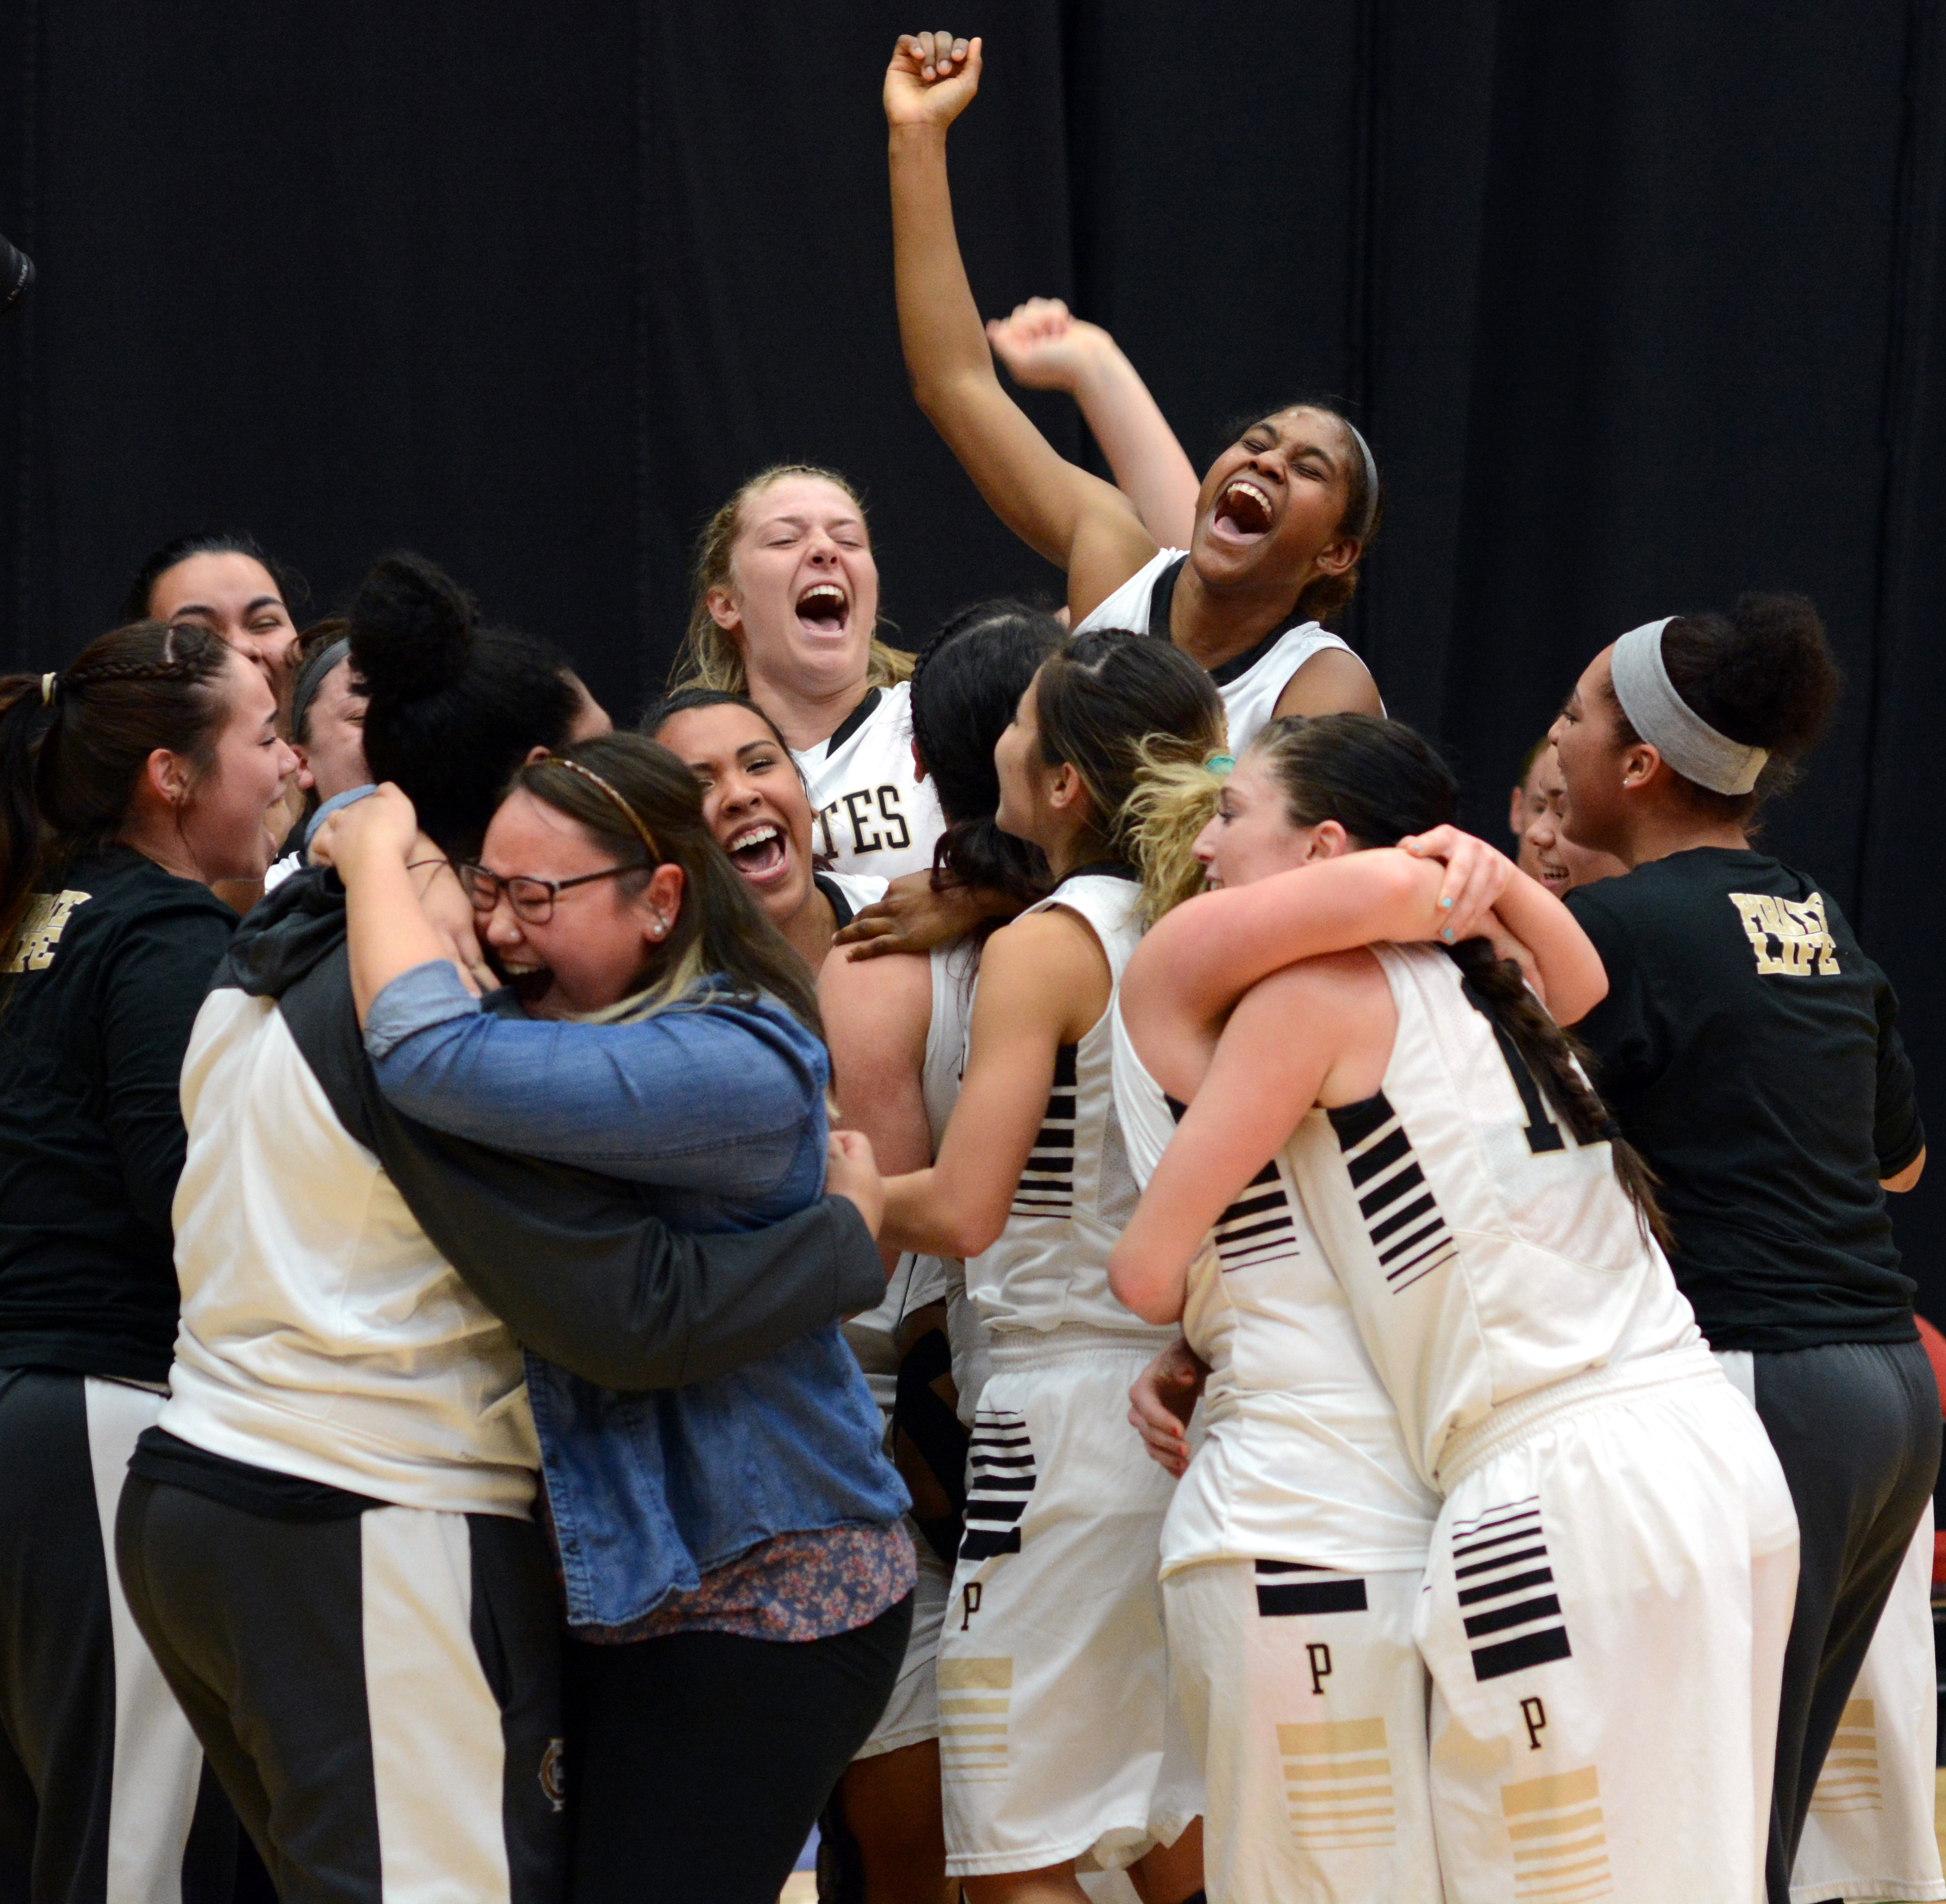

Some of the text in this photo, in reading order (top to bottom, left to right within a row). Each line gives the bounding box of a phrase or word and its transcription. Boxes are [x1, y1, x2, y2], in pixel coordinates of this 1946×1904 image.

[1747, 931, 1841, 976] LIFE
[961, 1582, 982, 1631] P
[1306, 1643, 1332, 1695] P
[1520, 1697, 1546, 1750] P
